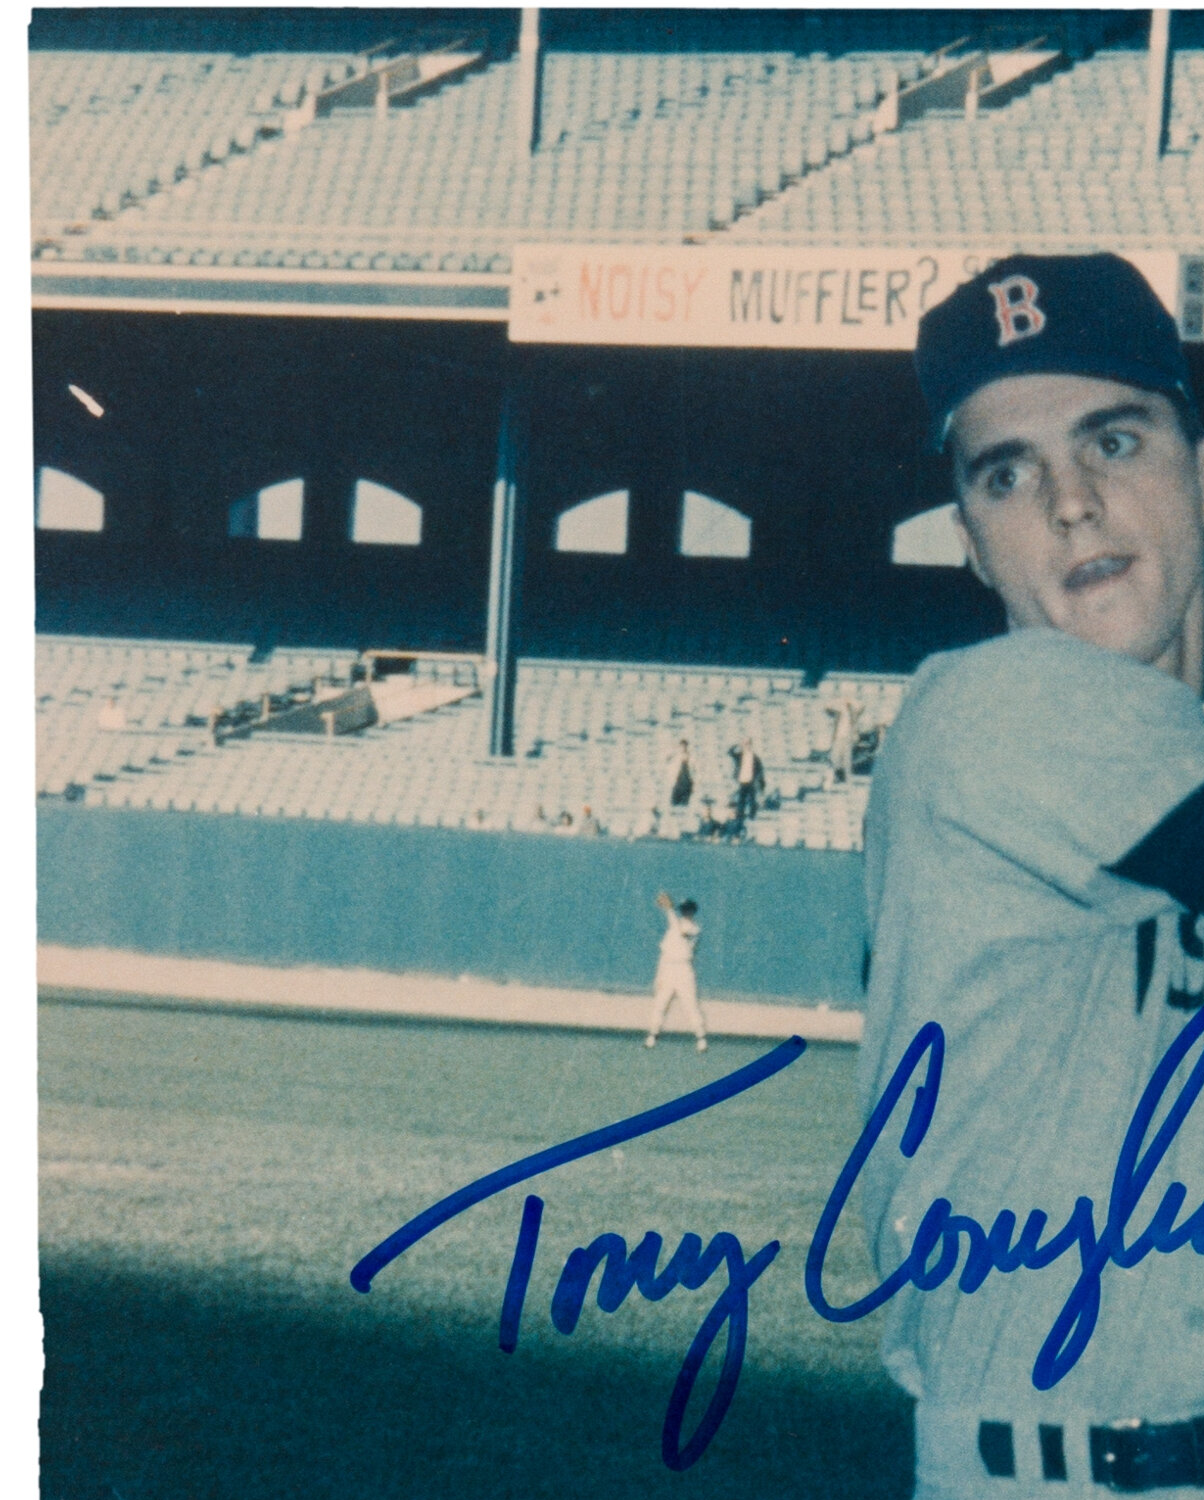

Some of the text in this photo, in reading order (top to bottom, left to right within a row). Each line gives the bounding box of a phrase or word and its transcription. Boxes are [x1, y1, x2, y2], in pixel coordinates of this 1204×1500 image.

[577, 256, 939, 327] NOISY MUFFLER?
[988, 275, 1046, 347] B
[351, 1034, 807, 1471] Tony
